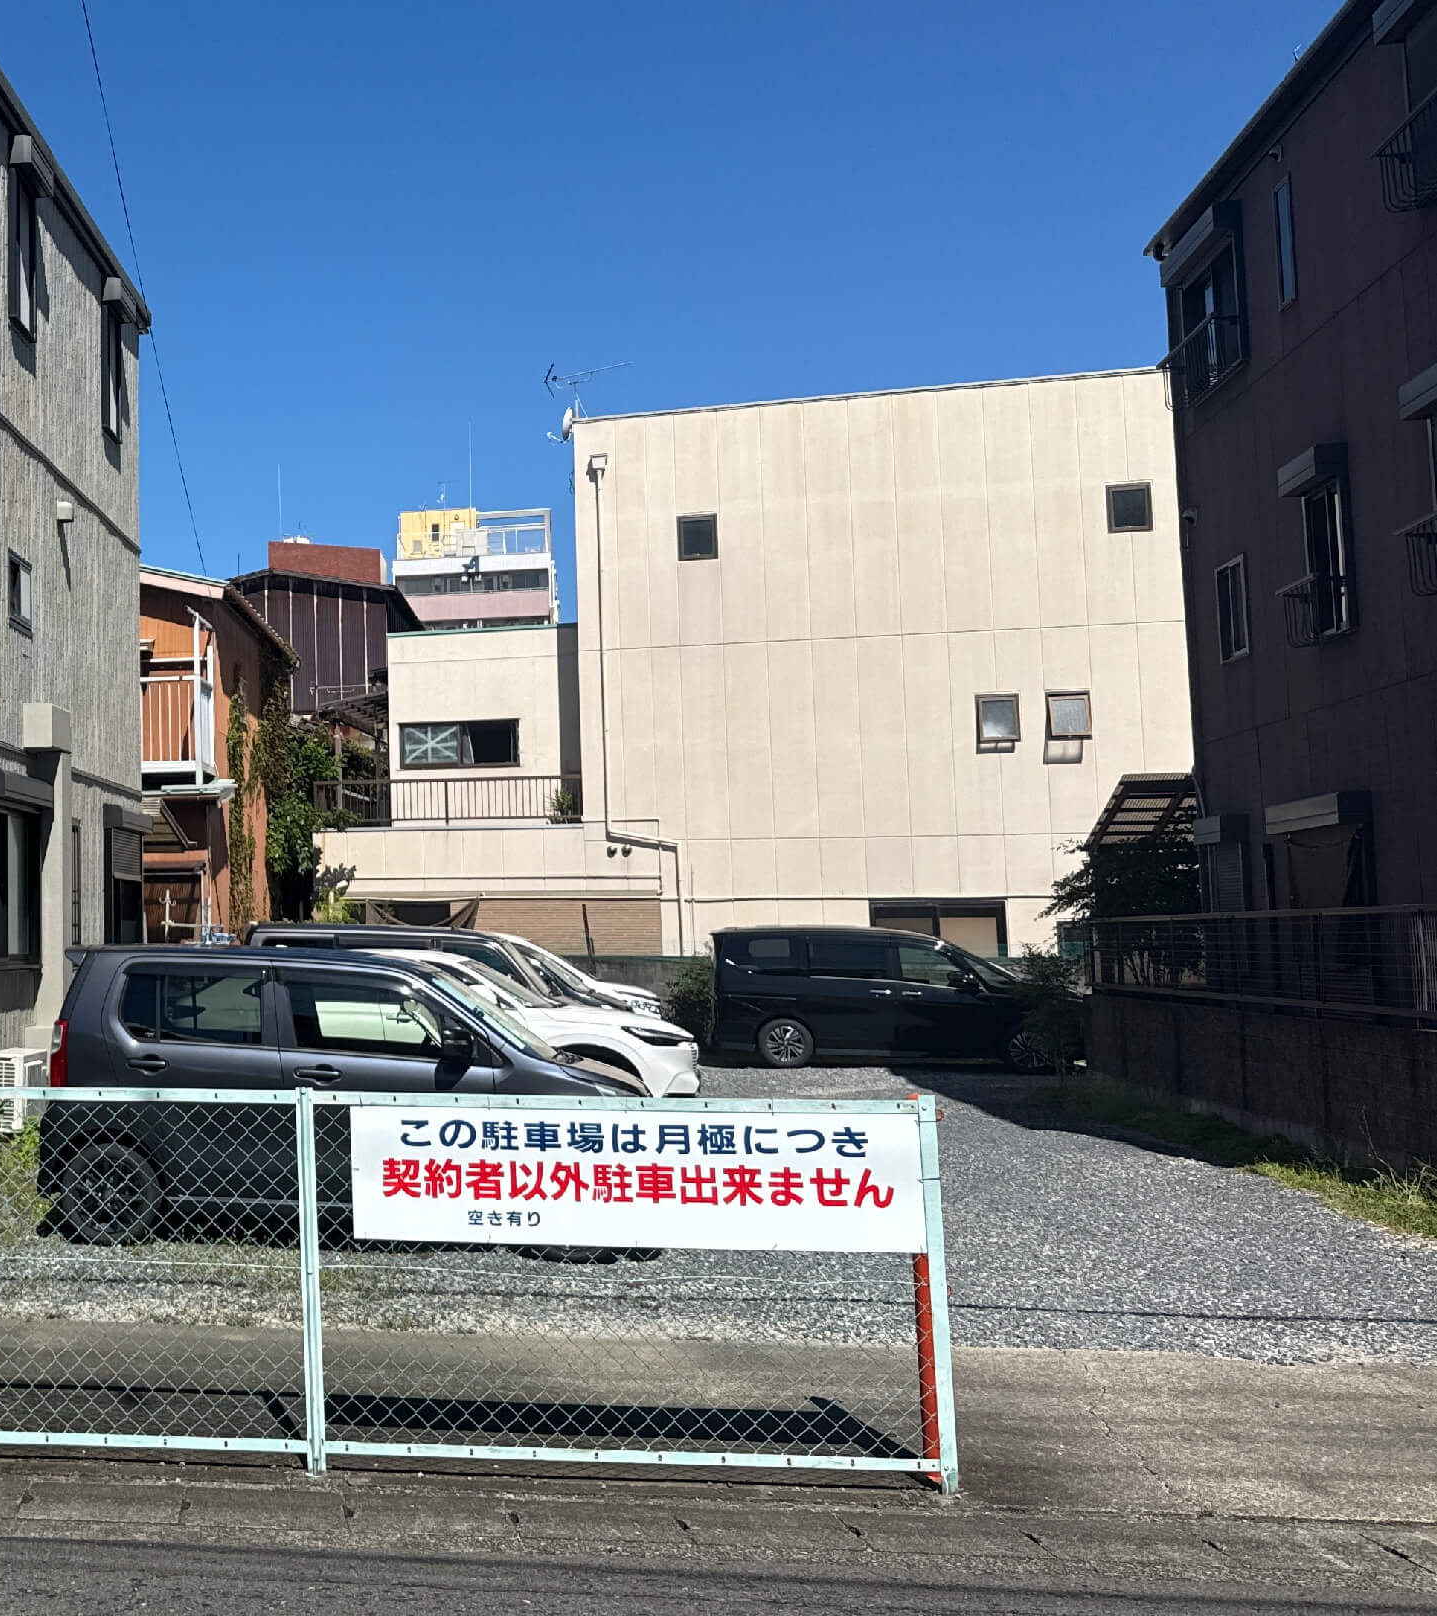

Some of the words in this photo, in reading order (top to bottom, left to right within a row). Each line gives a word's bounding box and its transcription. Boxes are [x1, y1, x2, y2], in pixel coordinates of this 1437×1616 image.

[400, 1119, 870, 1158] この駐車場は月極につき
[382, 1157, 895, 1210] 契約者以外駐車出来ません
[467, 1209, 541, 1227] 空き有り
